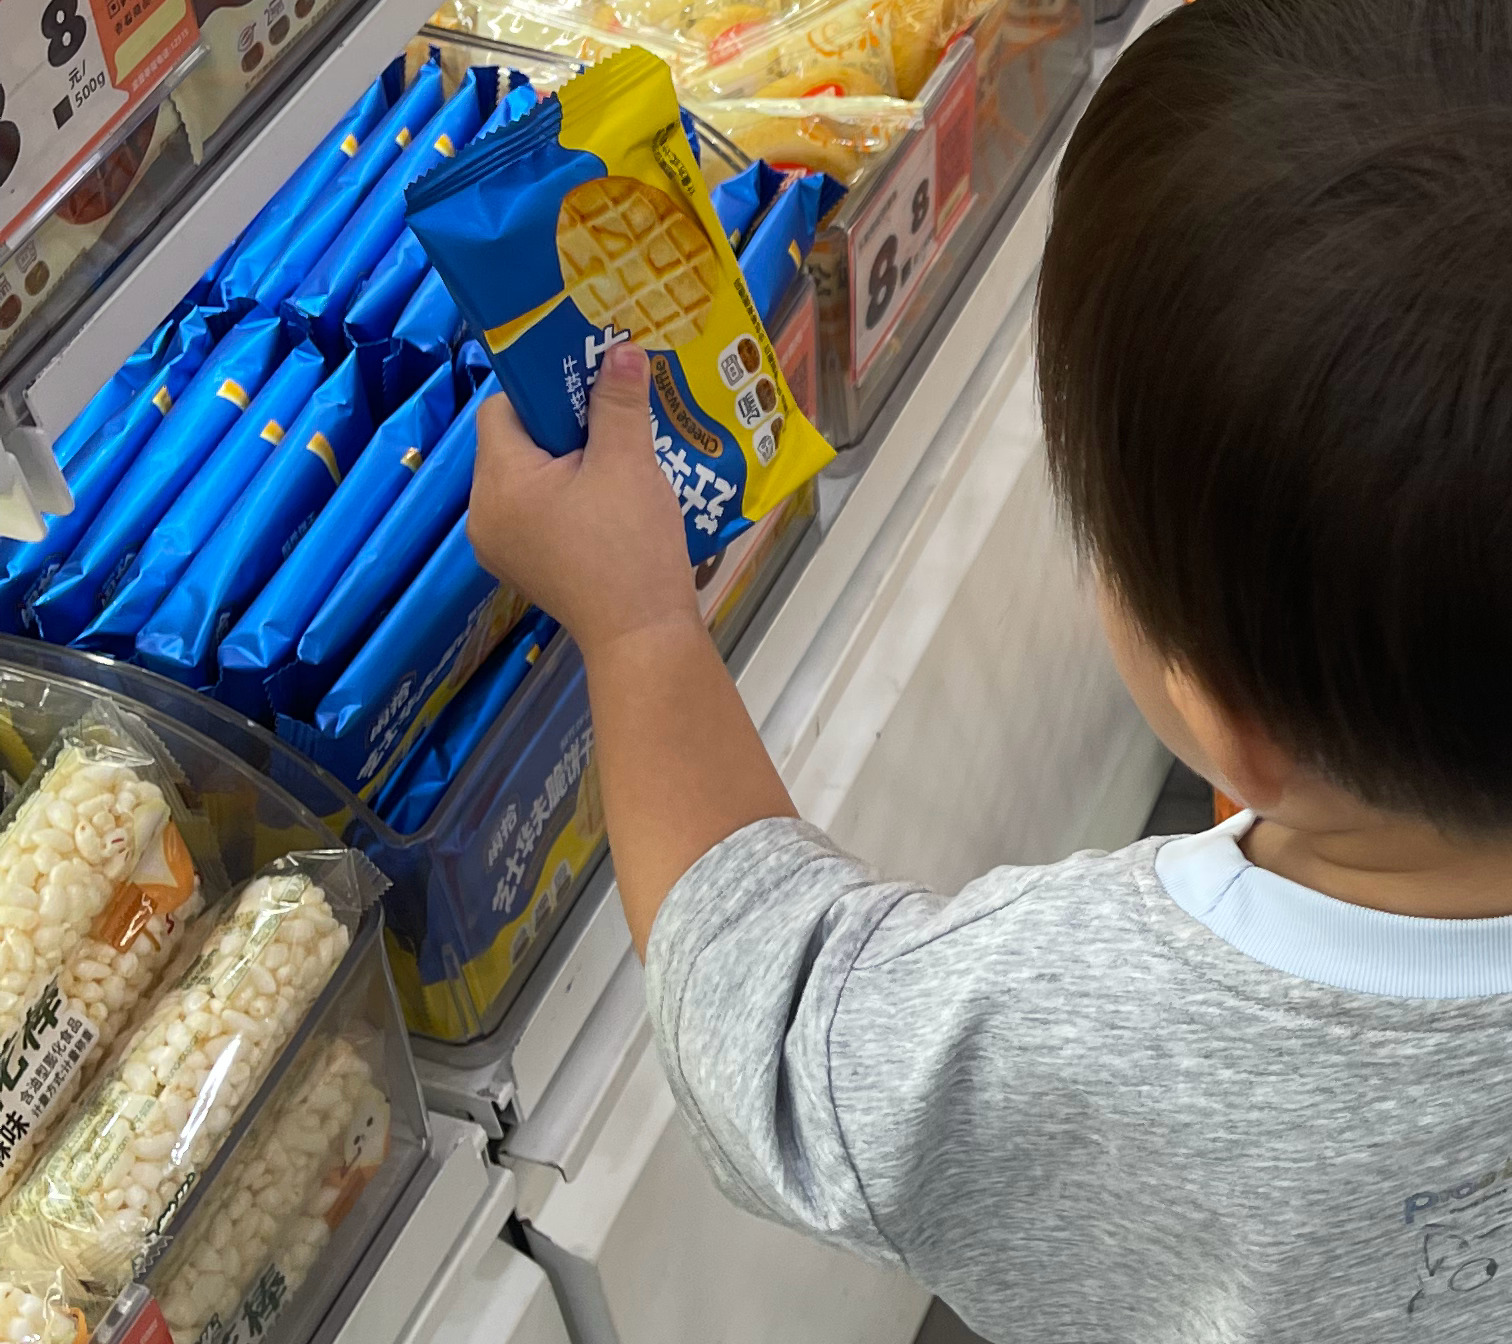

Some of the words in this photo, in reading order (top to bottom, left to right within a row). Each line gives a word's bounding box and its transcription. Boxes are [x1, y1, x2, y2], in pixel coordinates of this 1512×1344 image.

[75, 71, 106, 108] 500g
[865, 177, 931, 331] 8.8
[655, 358, 681, 414] waffle
[677, 414, 718, 454] Cheese
